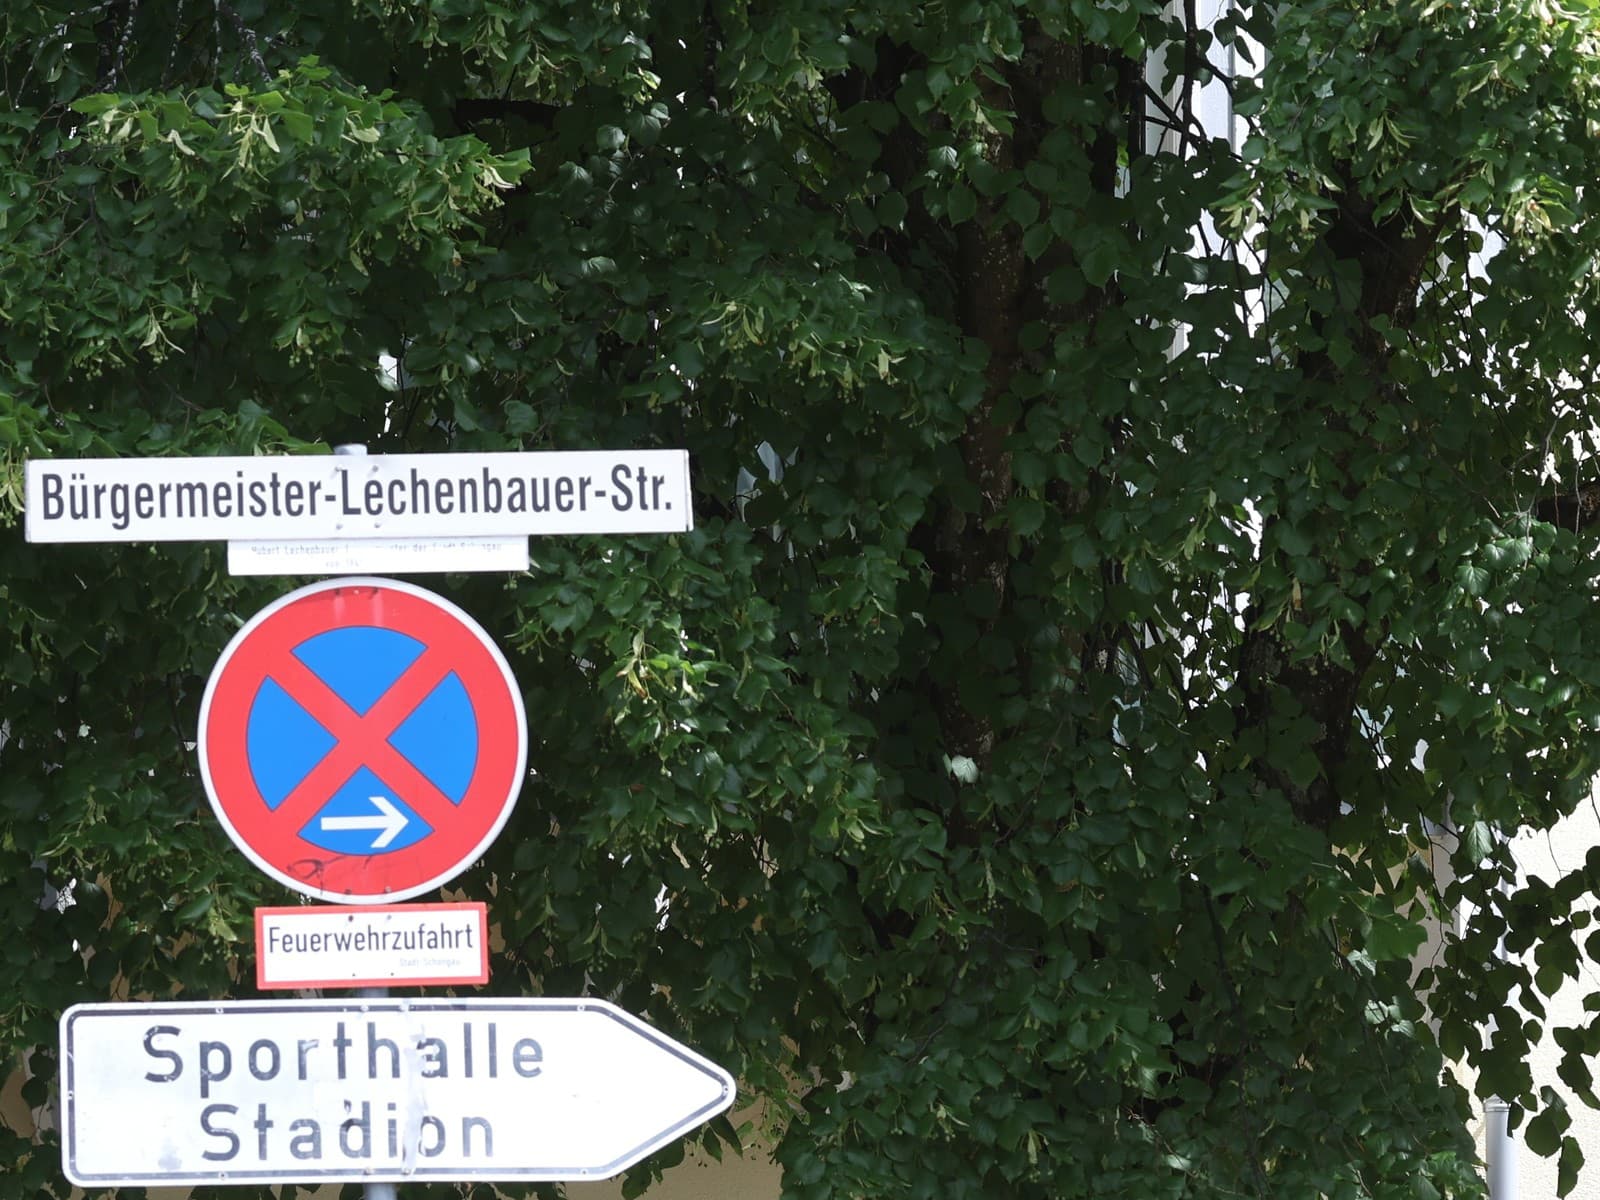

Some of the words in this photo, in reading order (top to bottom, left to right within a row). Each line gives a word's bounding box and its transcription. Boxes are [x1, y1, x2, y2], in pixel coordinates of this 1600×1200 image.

[43, 463, 672, 520] Bürgermeister-Lechenbauer-Str.
[268, 922, 473, 953] Feuerwehrzufahrt
[144, 1022, 542, 1099] Sporthalle
[201, 1099, 493, 1161] Stadion
